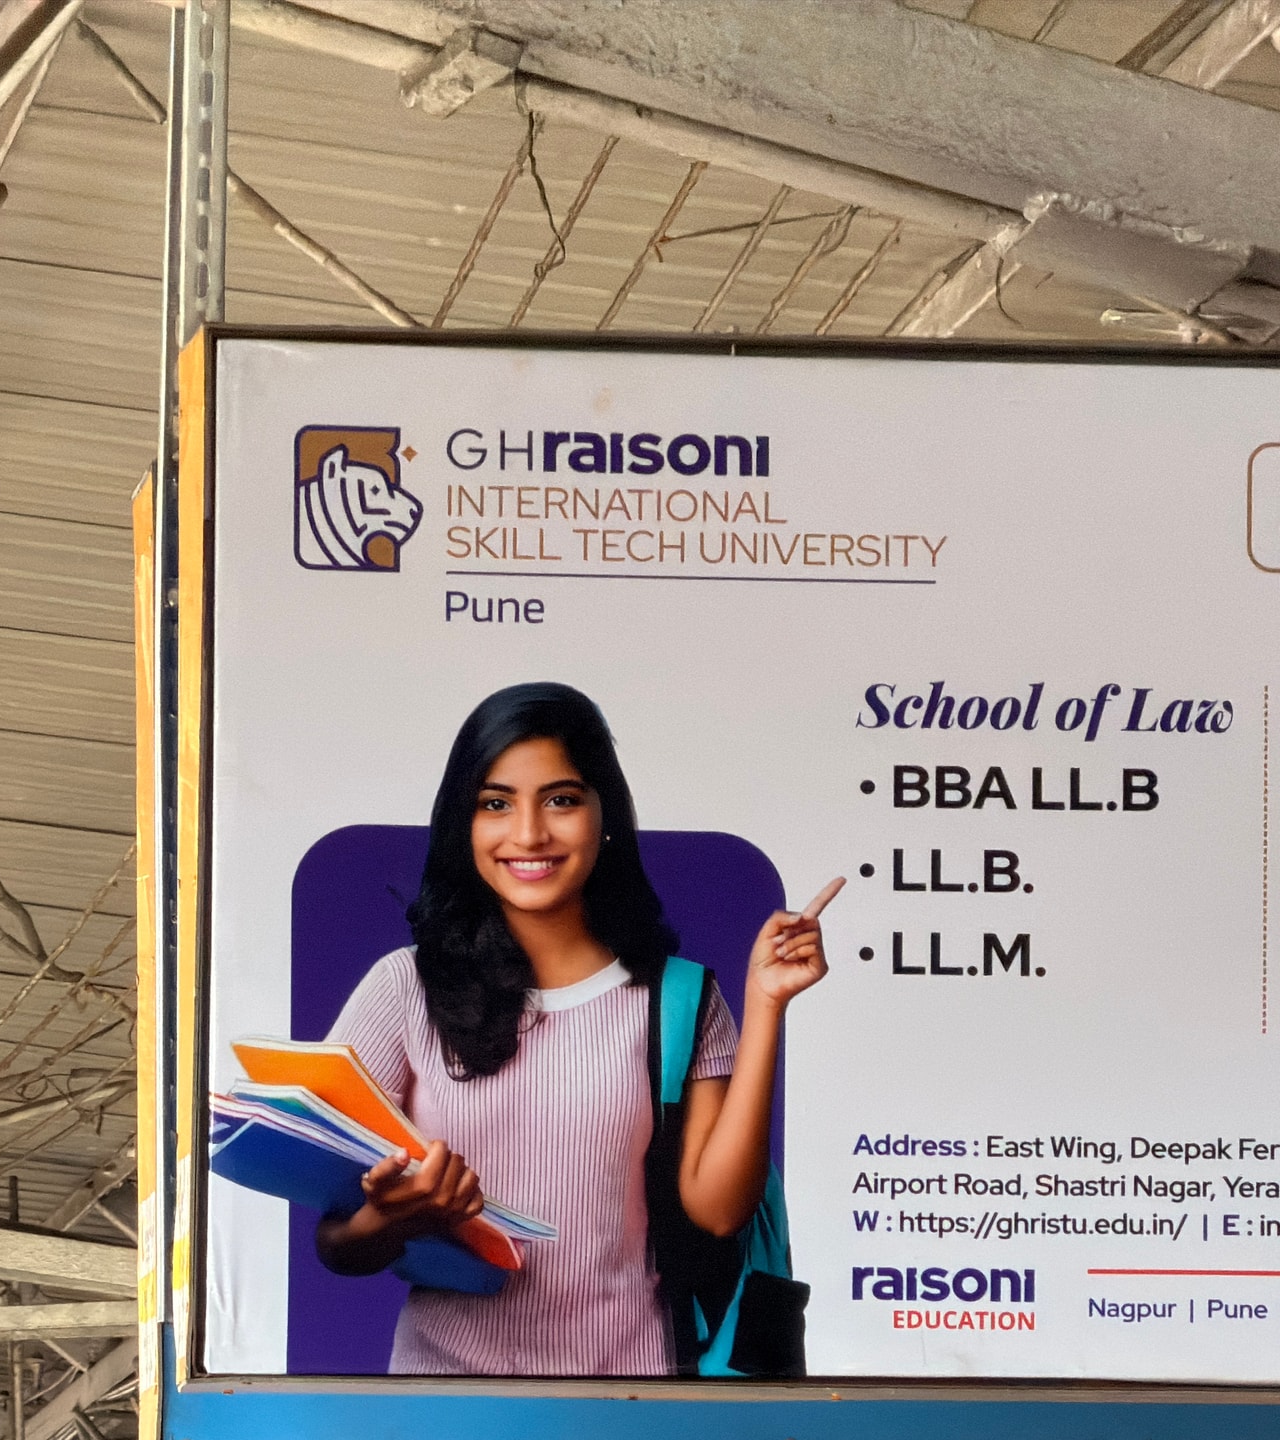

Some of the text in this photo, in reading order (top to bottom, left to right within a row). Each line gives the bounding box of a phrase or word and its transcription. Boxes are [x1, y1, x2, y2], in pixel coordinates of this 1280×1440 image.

[448, 485, 787, 524] INTERNATIONAL
[447, 526, 947, 567] SKILL TECH UNIVERSITY
[446, 591, 544, 624] Pune
[856, 681, 1233, 742] School of Law
[893, 765, 1159, 811] BBA LL.B
[893, 848, 1034, 894] LL.B.
[892, 931, 1046, 977] LL.M.
[987, 1136, 1044, 1158] East
[1050, 1136, 1122, 1164] Wing,
[1131, 1137, 1232, 1165] Deepak
[852, 1172, 948, 1200] Airport
[954, 1173, 1028, 1200] Road,
[1035, 1174, 1125, 1196] Shastri
[1134, 1175, 1215, 1203] Nagar,
[900, 1210, 1188, 1241] https://ghristu.edu.in/
[852, 1267, 1035, 1303] raisoni
[894, 1311, 1034, 1330] EDUCATION
[1089, 1298, 1177, 1322] Nagpur
[1208, 1299, 1268, 1319] Pune
